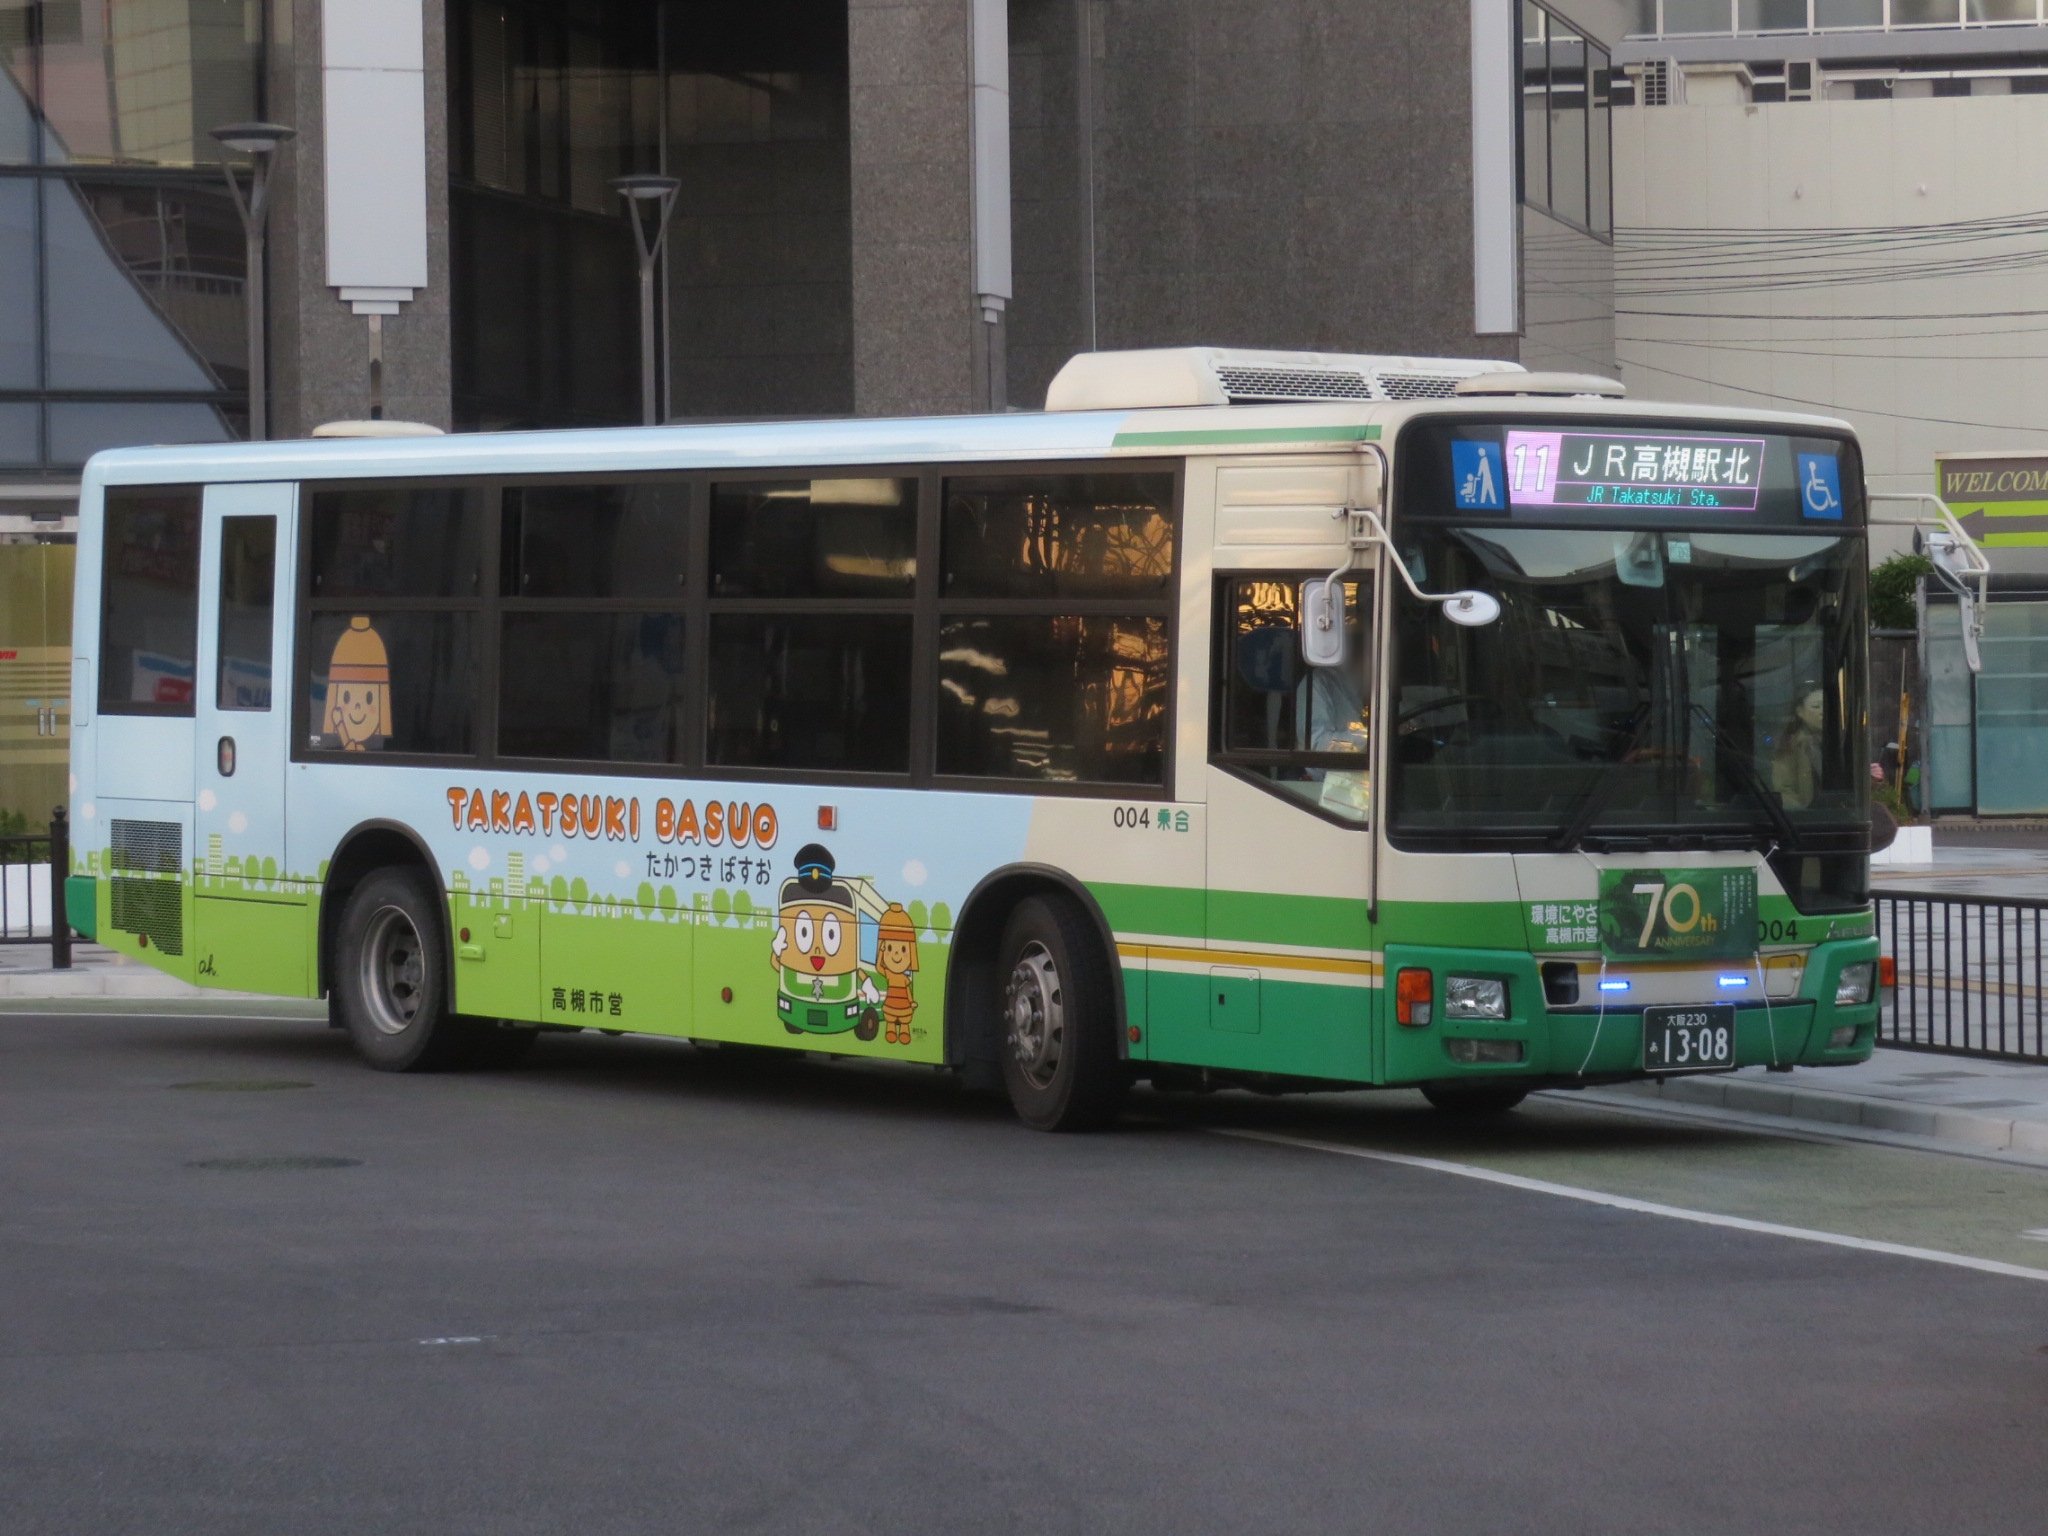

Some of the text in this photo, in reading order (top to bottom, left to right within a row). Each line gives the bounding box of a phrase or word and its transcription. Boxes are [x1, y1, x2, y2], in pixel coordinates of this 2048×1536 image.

[1513, 444, 1550, 492] 11
[1946, 470, 2048, 494] WELCOM
[1586, 485, 1720, 506] JR Takatsuki Sta.
[447, 786, 779, 851] TAKATSUKI BASUO
[1113, 806, 1150, 829] 004
[552, 987, 623, 1016] 高槻市営
[1664, 1027, 1728, 1063] 13-08
